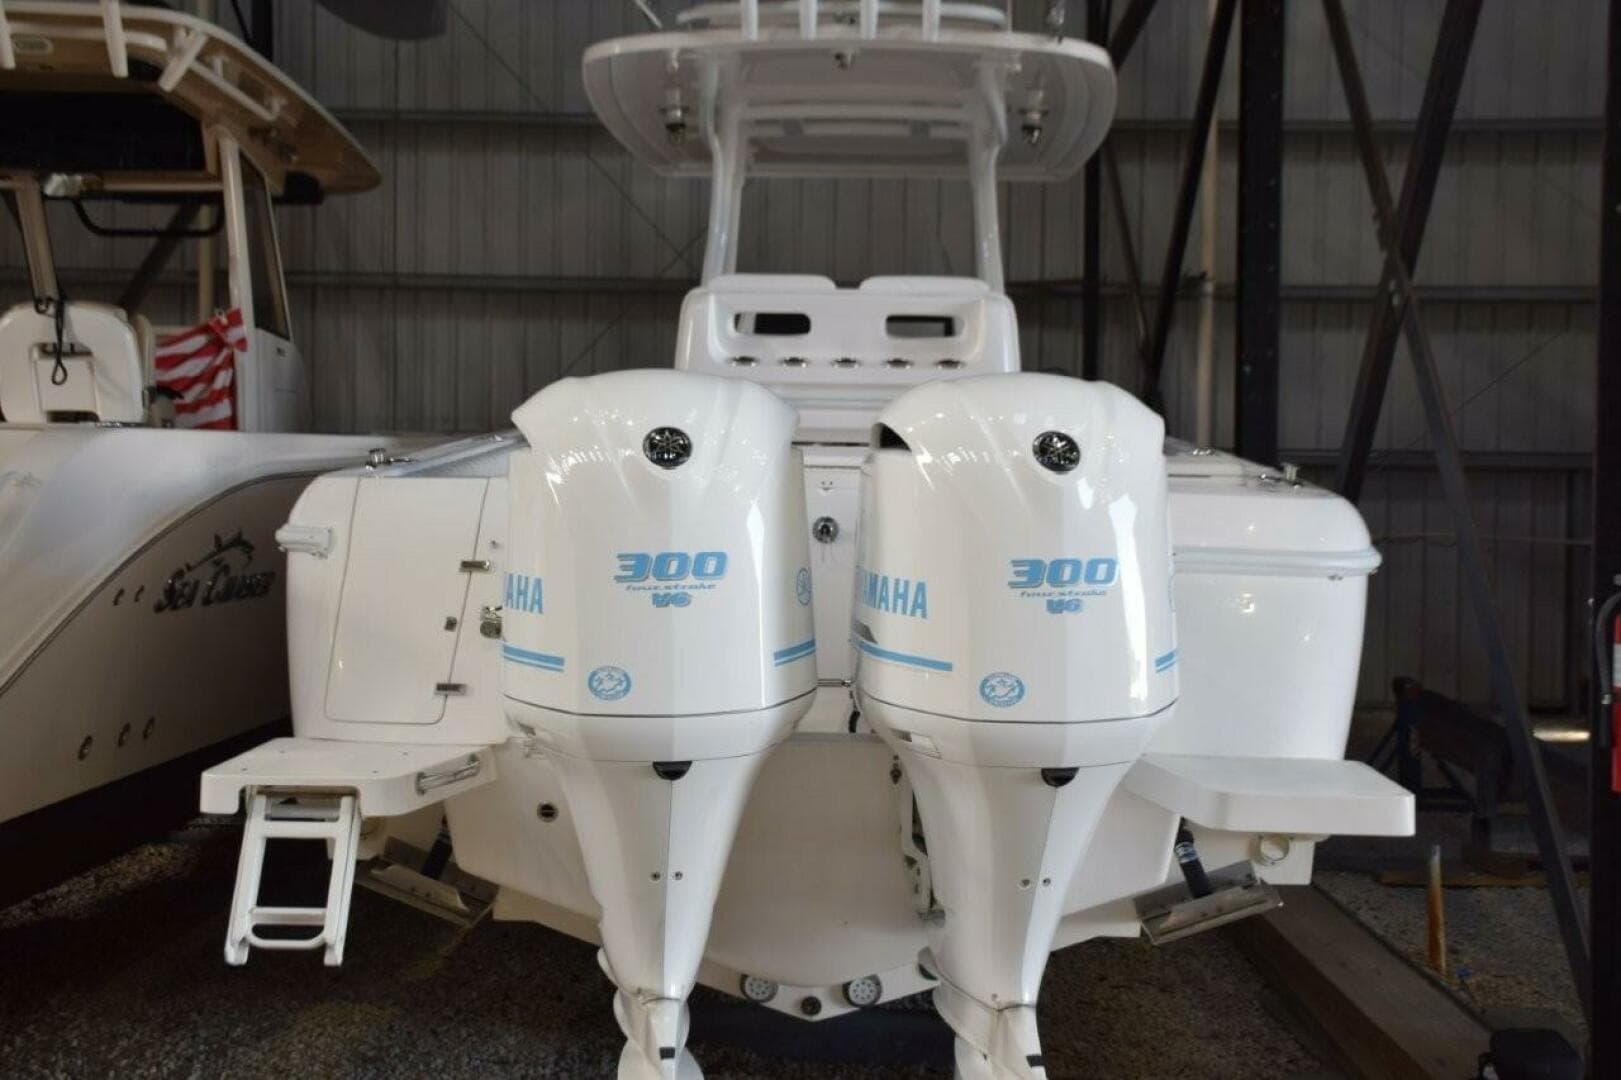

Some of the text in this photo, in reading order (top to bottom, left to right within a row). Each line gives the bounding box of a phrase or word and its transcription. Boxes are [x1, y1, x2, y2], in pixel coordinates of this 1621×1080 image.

[614, 551, 728, 583] 300
[1007, 558, 1118, 589] 300
[651, 591, 692, 608] V6
[1046, 598, 1081, 614] V6
